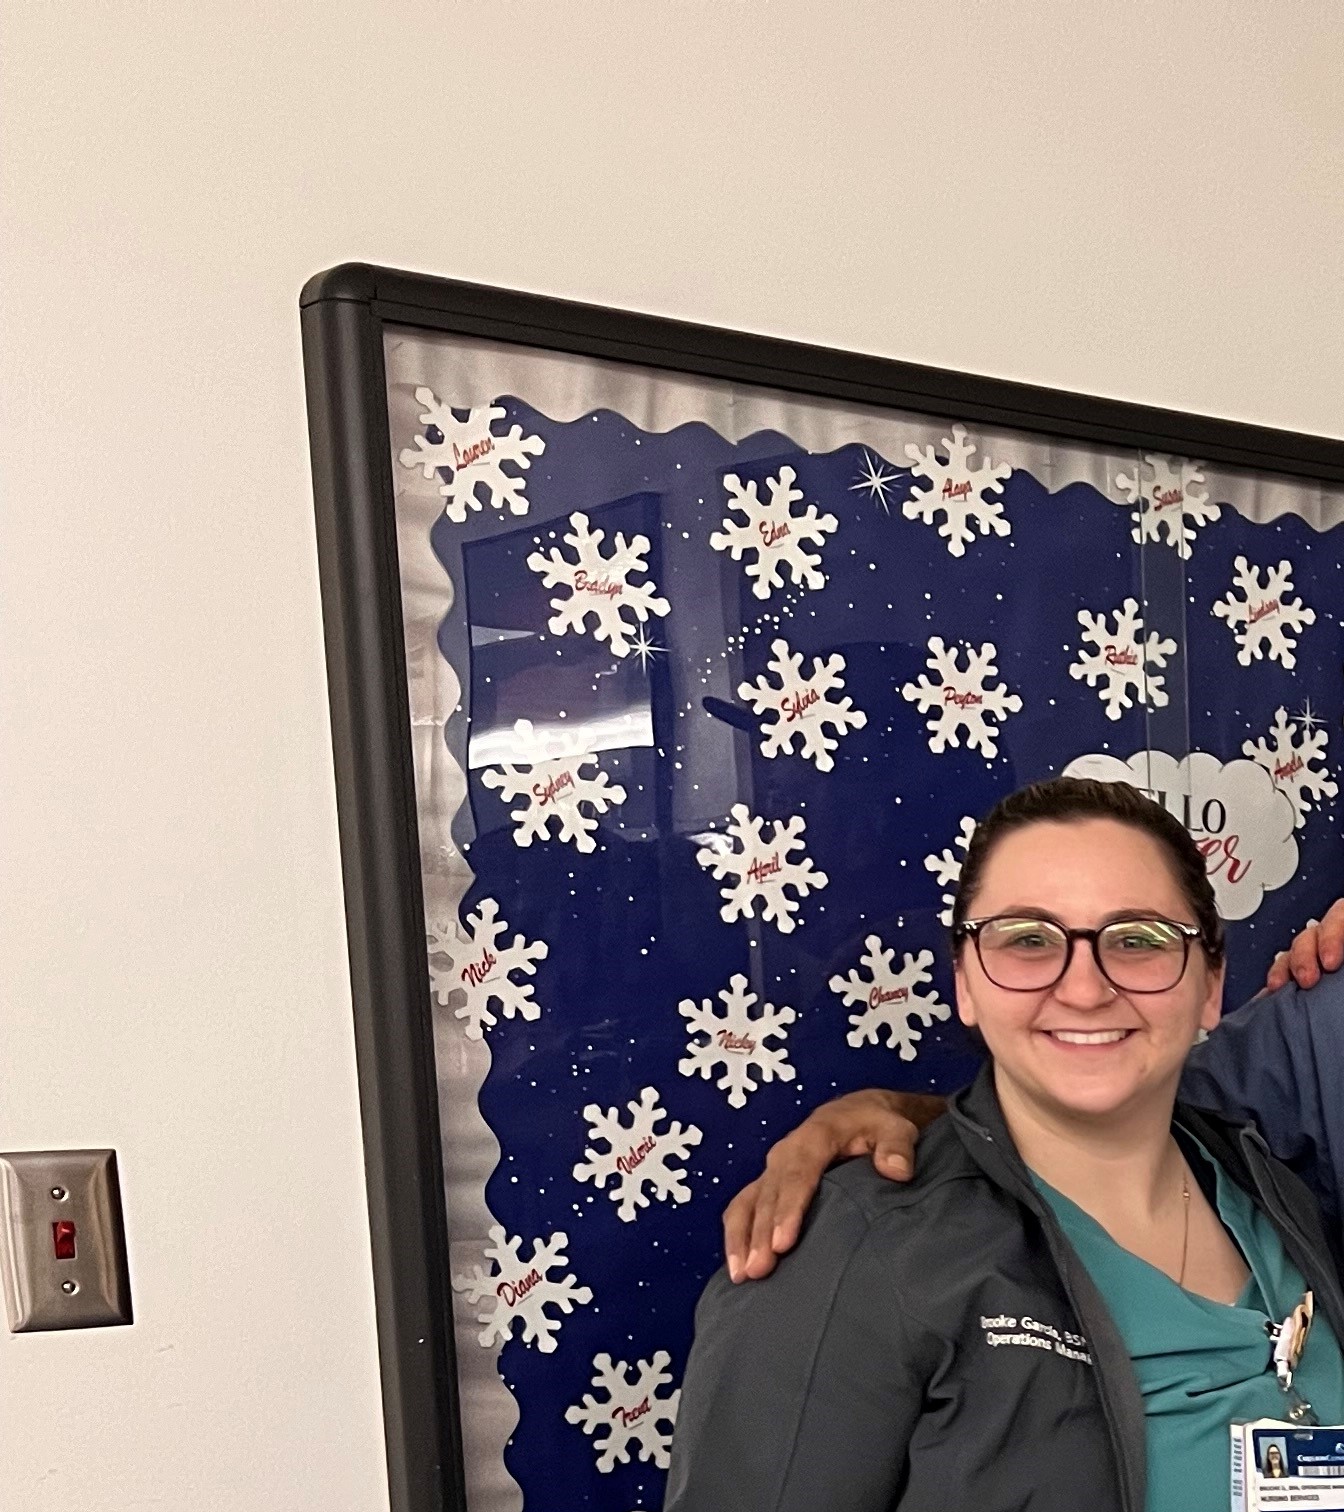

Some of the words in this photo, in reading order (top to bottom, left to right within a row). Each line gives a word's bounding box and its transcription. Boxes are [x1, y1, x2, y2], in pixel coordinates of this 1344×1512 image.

[453, 437, 495, 471] Lauren
[759, 520, 791, 547] Edna
[781, 689, 821, 723] Sylvia
[943, 686, 983, 710] Peyton
[533, 771, 576, 806] Sydney
[747, 852, 782, 884] April
[461, 947, 496, 987] Nick
[617, 1136, 656, 1175] Valerie
[497, 1268, 543, 1307] Diana
[986, 1331, 1052, 1350] Operations
